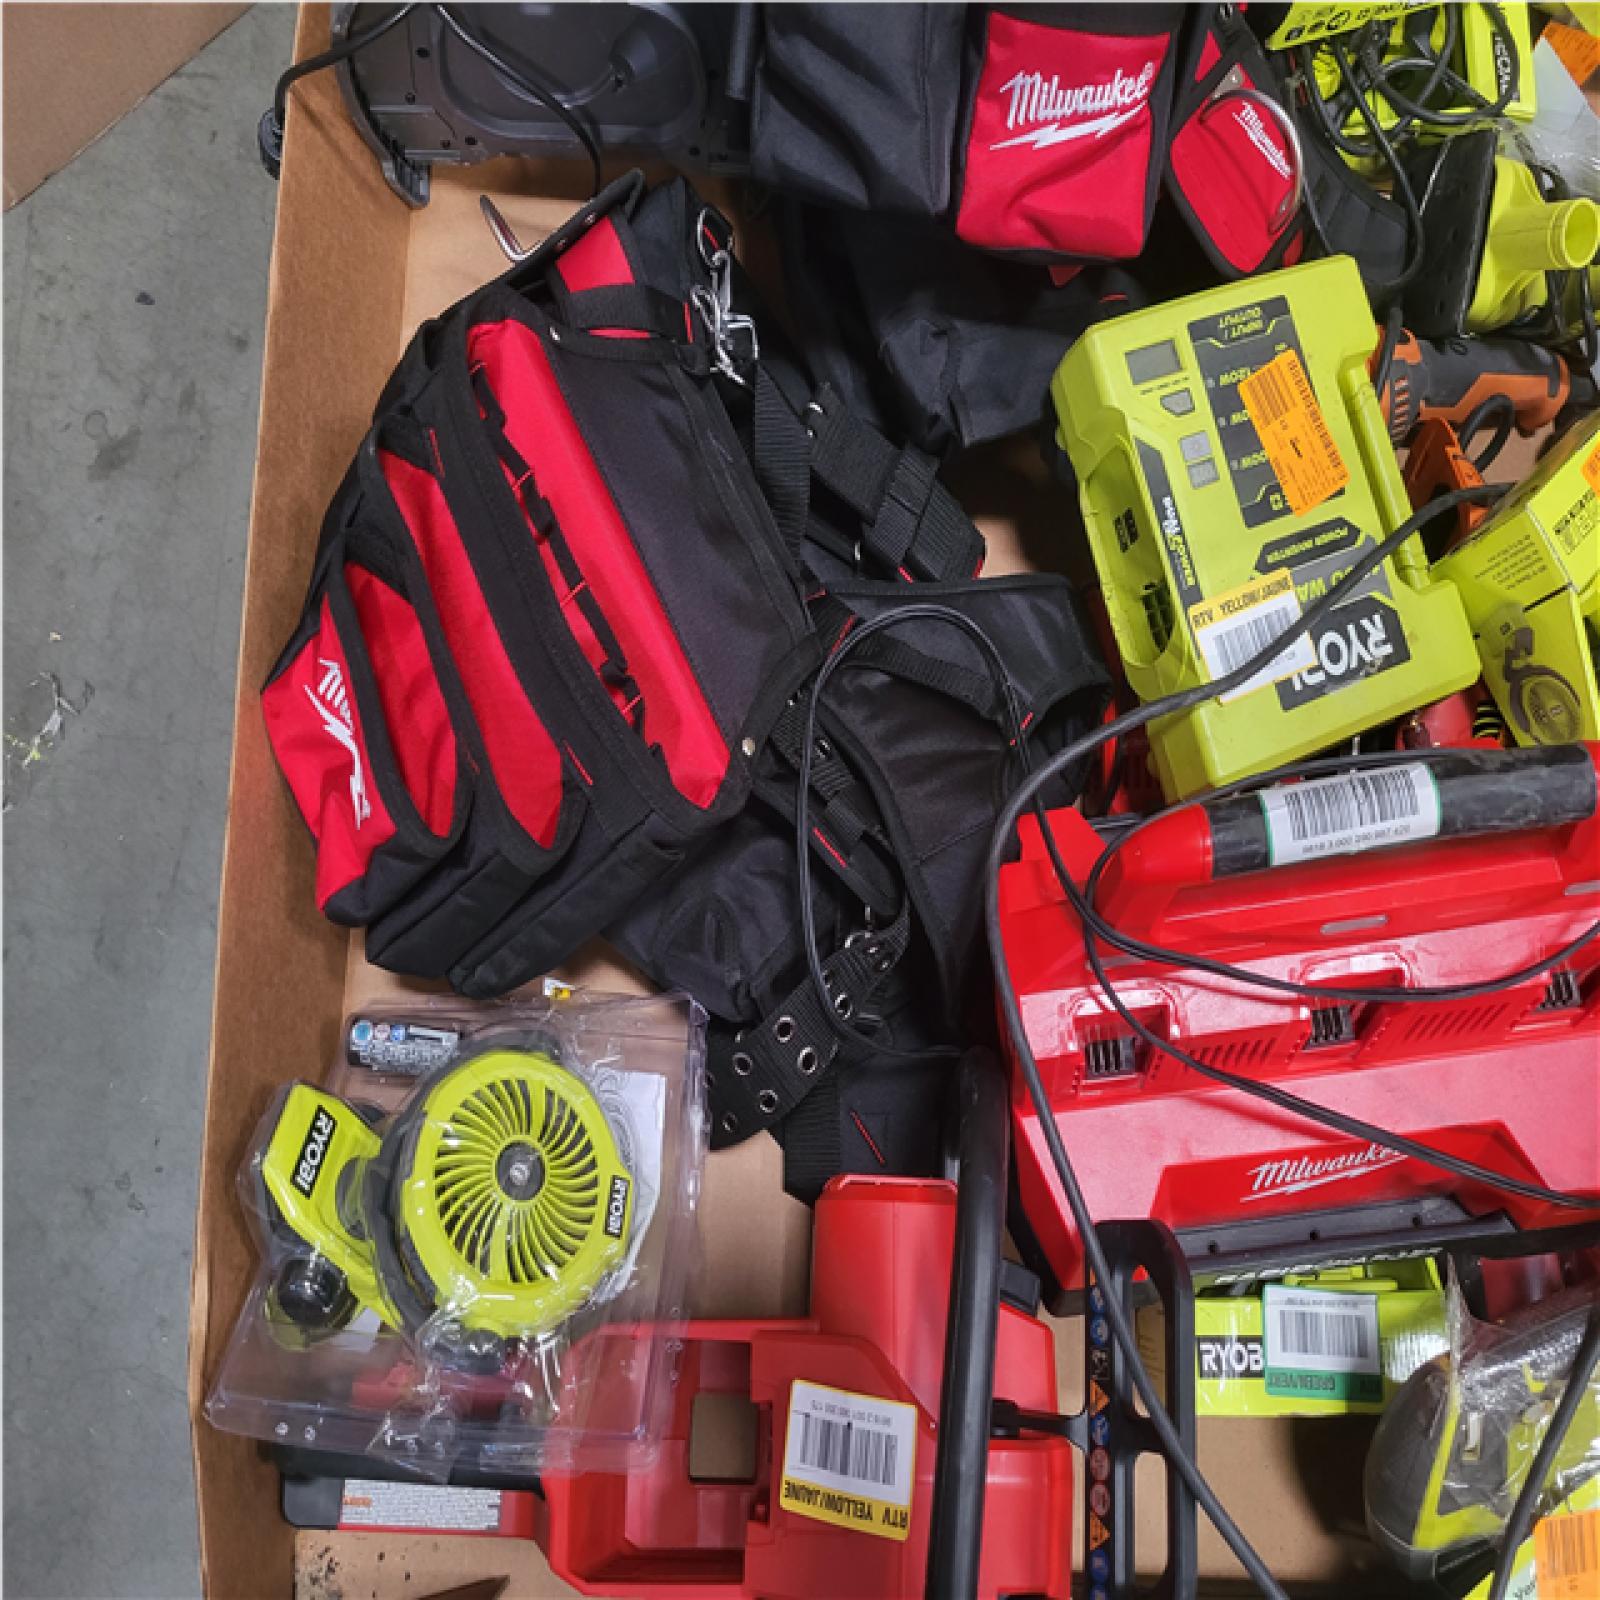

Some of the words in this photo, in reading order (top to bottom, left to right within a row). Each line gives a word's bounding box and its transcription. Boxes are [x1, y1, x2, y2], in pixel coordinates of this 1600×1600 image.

[1000, 67, 1150, 130] Milwaukee
[295, 1111, 334, 1191] RYOBI
[607, 1178, 626, 1235] RYOBI
[1200, 1340, 1264, 1372] RYOB
[783, 1479, 873, 1522] YELLOW/JAUNE
[881, 1506, 909, 1531] RTV
